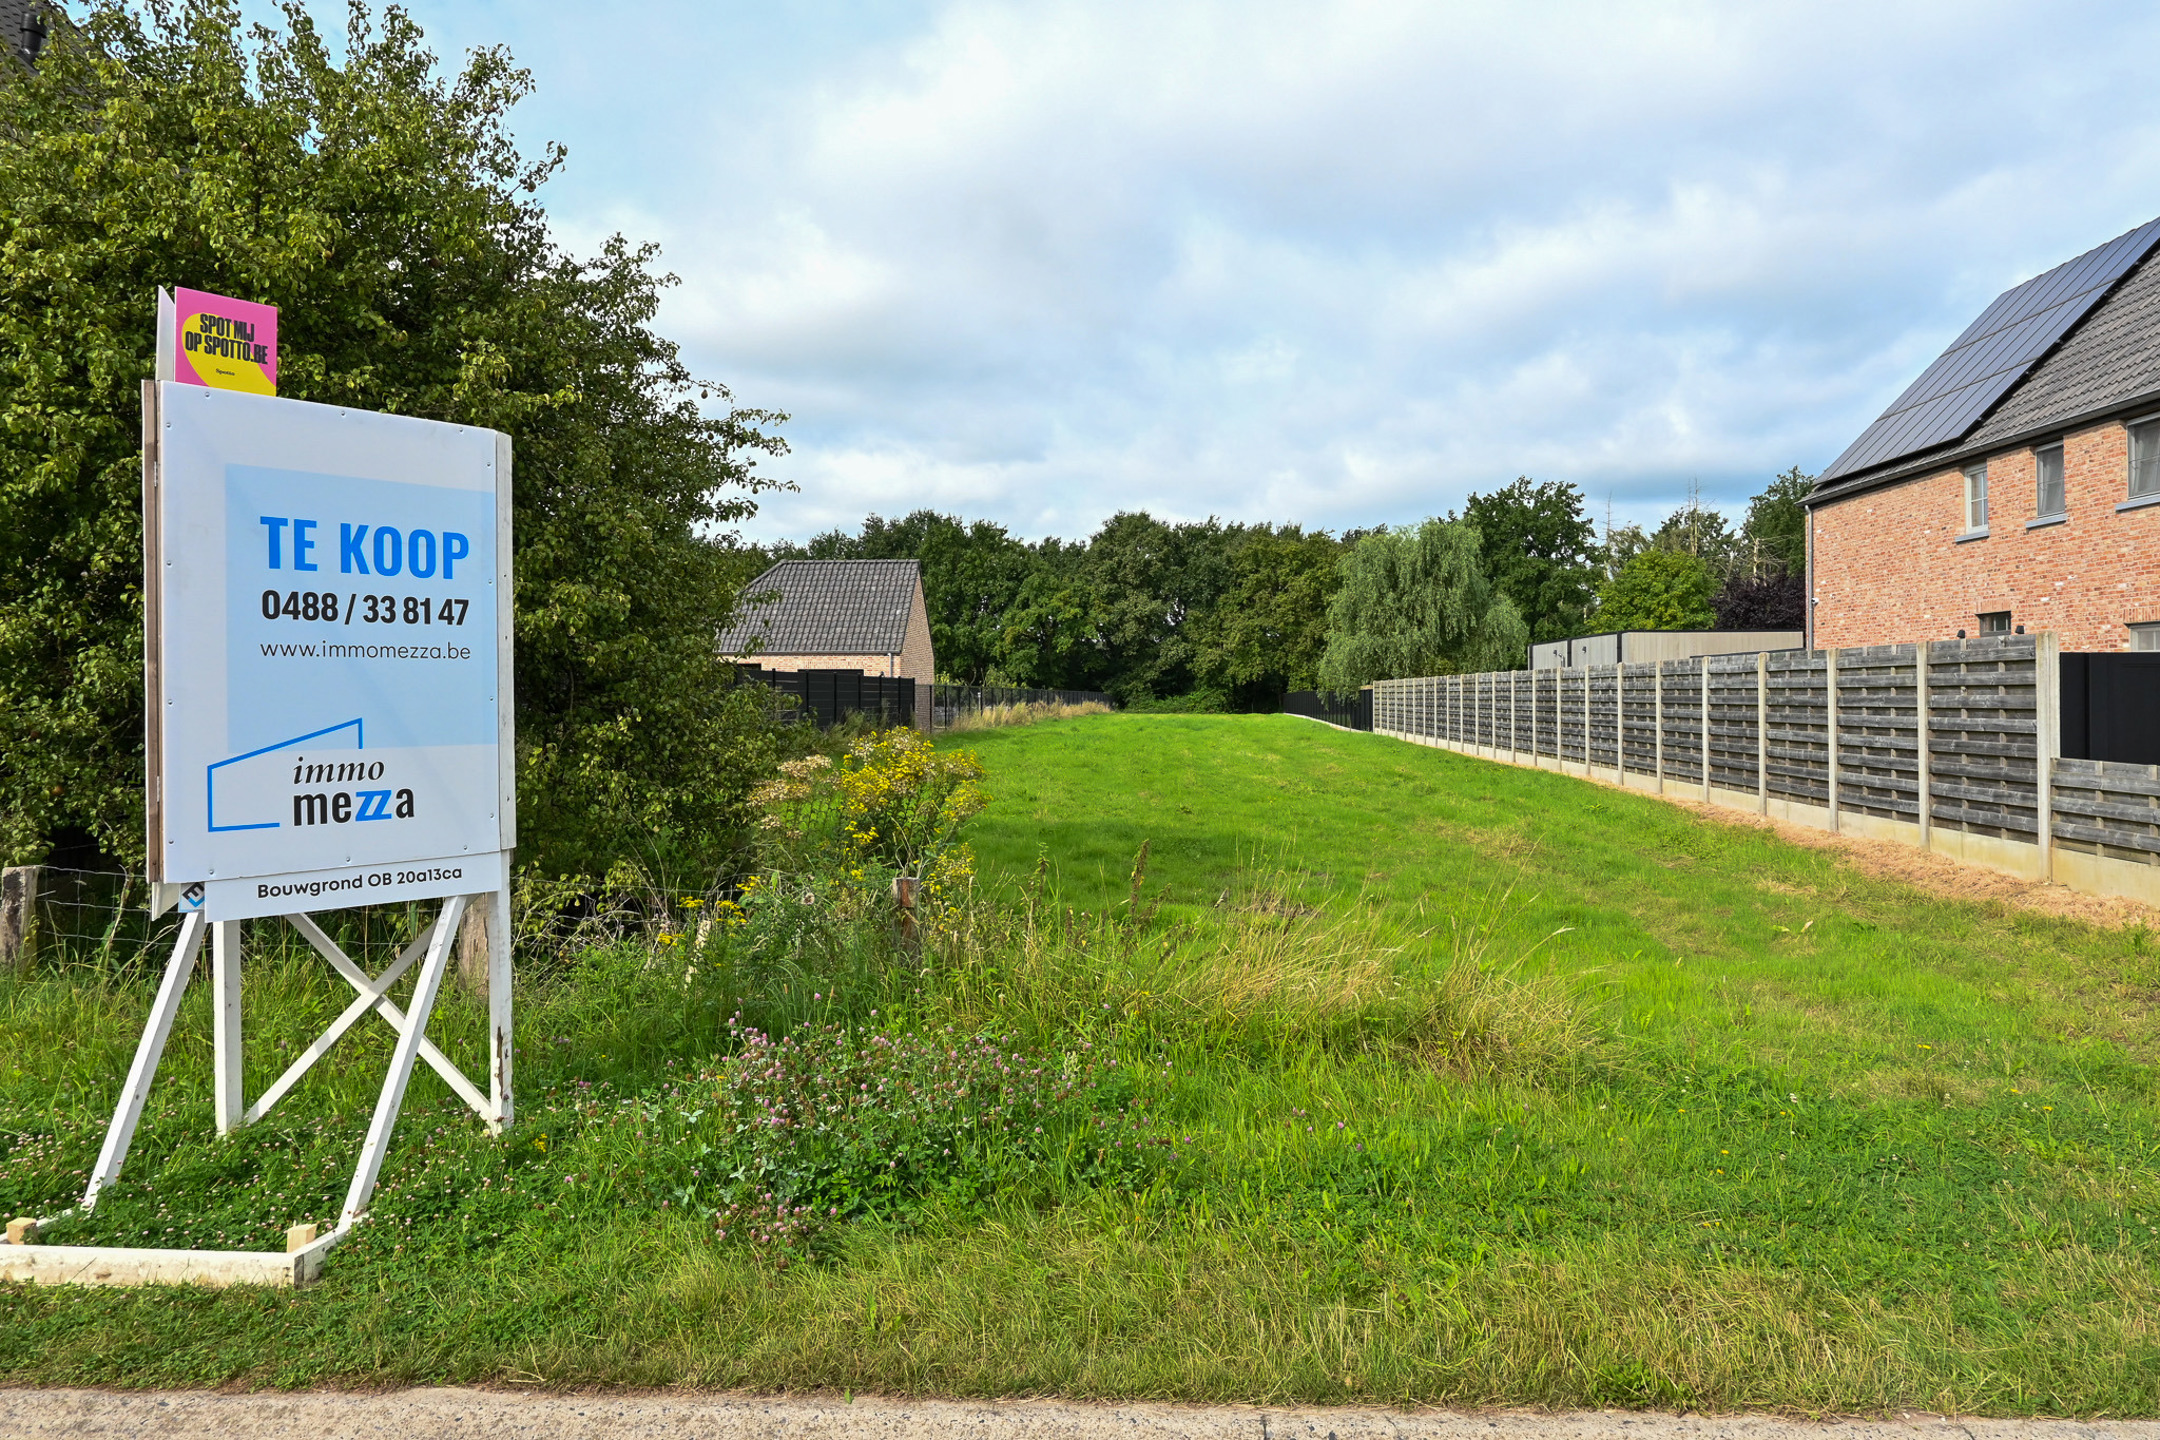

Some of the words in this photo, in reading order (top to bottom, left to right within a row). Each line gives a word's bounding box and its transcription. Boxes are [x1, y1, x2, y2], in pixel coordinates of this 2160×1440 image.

[199, 313, 232, 338] SPOT
[234, 320, 255, 342] MIJ
[185, 331, 202, 352] OP
[204, 334, 268, 365] SPOTTO.BE
[260, 516, 318, 571] TE
[340, 522, 469, 580] KOOP
[261, 589, 338, 622] 0488
[362, 595, 396, 624] 33
[260, 640, 471, 660] www.immomezza.be
[293, 756, 385, 785] immo
[293, 788, 415, 827] mezza
[258, 874, 363, 898] Bouwgrond
[367, 873, 392, 887] OB
[397, 868, 462, 885] 20a13ca
